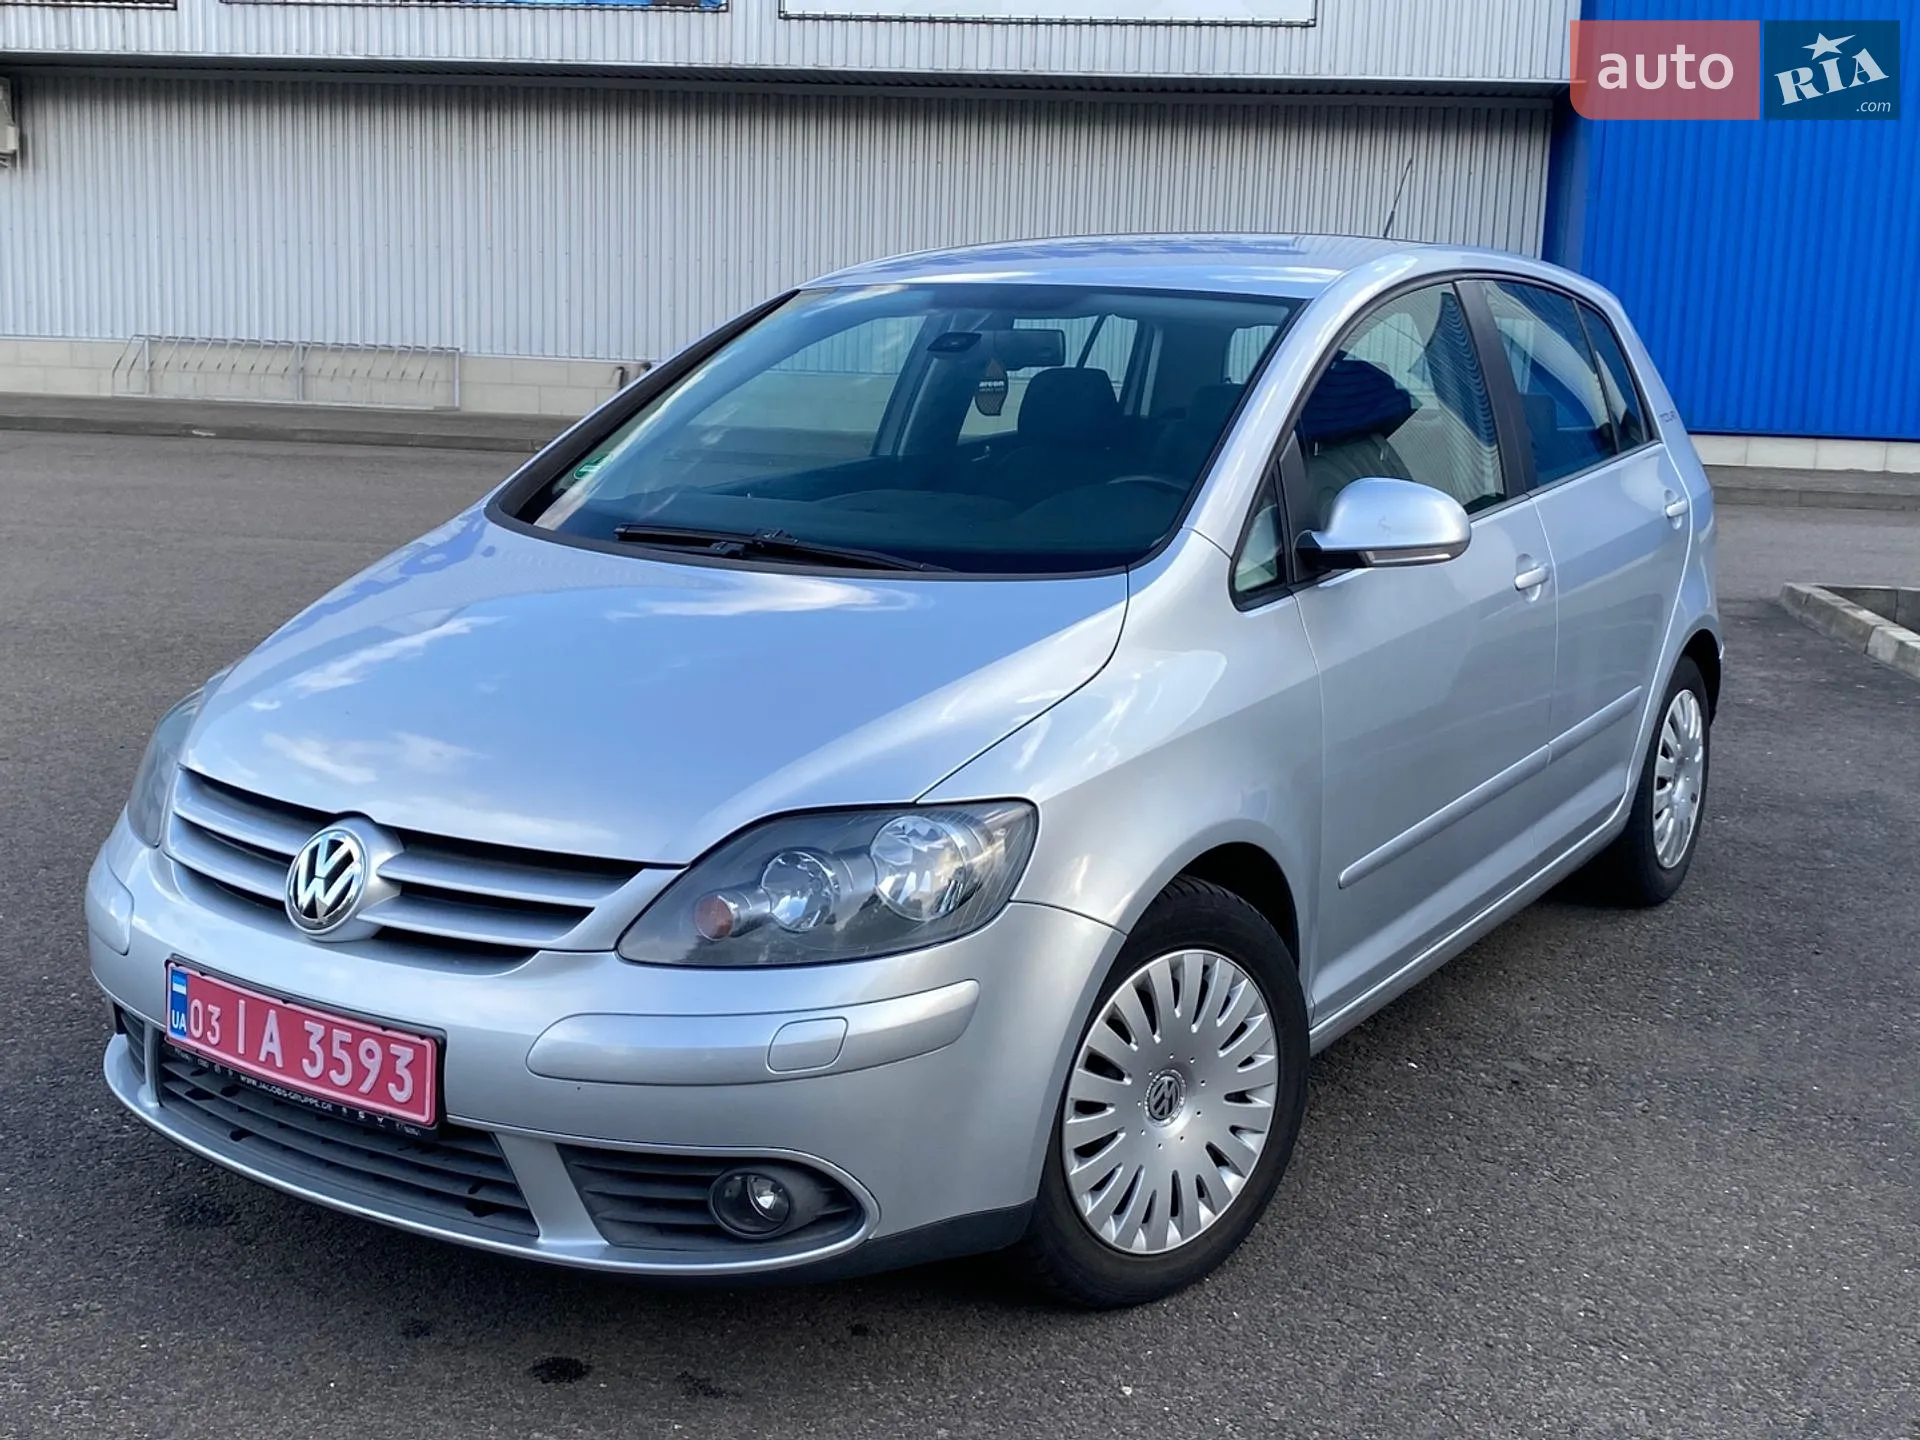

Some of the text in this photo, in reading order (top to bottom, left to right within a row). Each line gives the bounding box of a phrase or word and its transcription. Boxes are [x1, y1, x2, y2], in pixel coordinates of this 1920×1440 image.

[171, 1009, 187, 1032] UA
[189, 998, 222, 1046] 03
[301, 1020, 415, 1104] 3593
